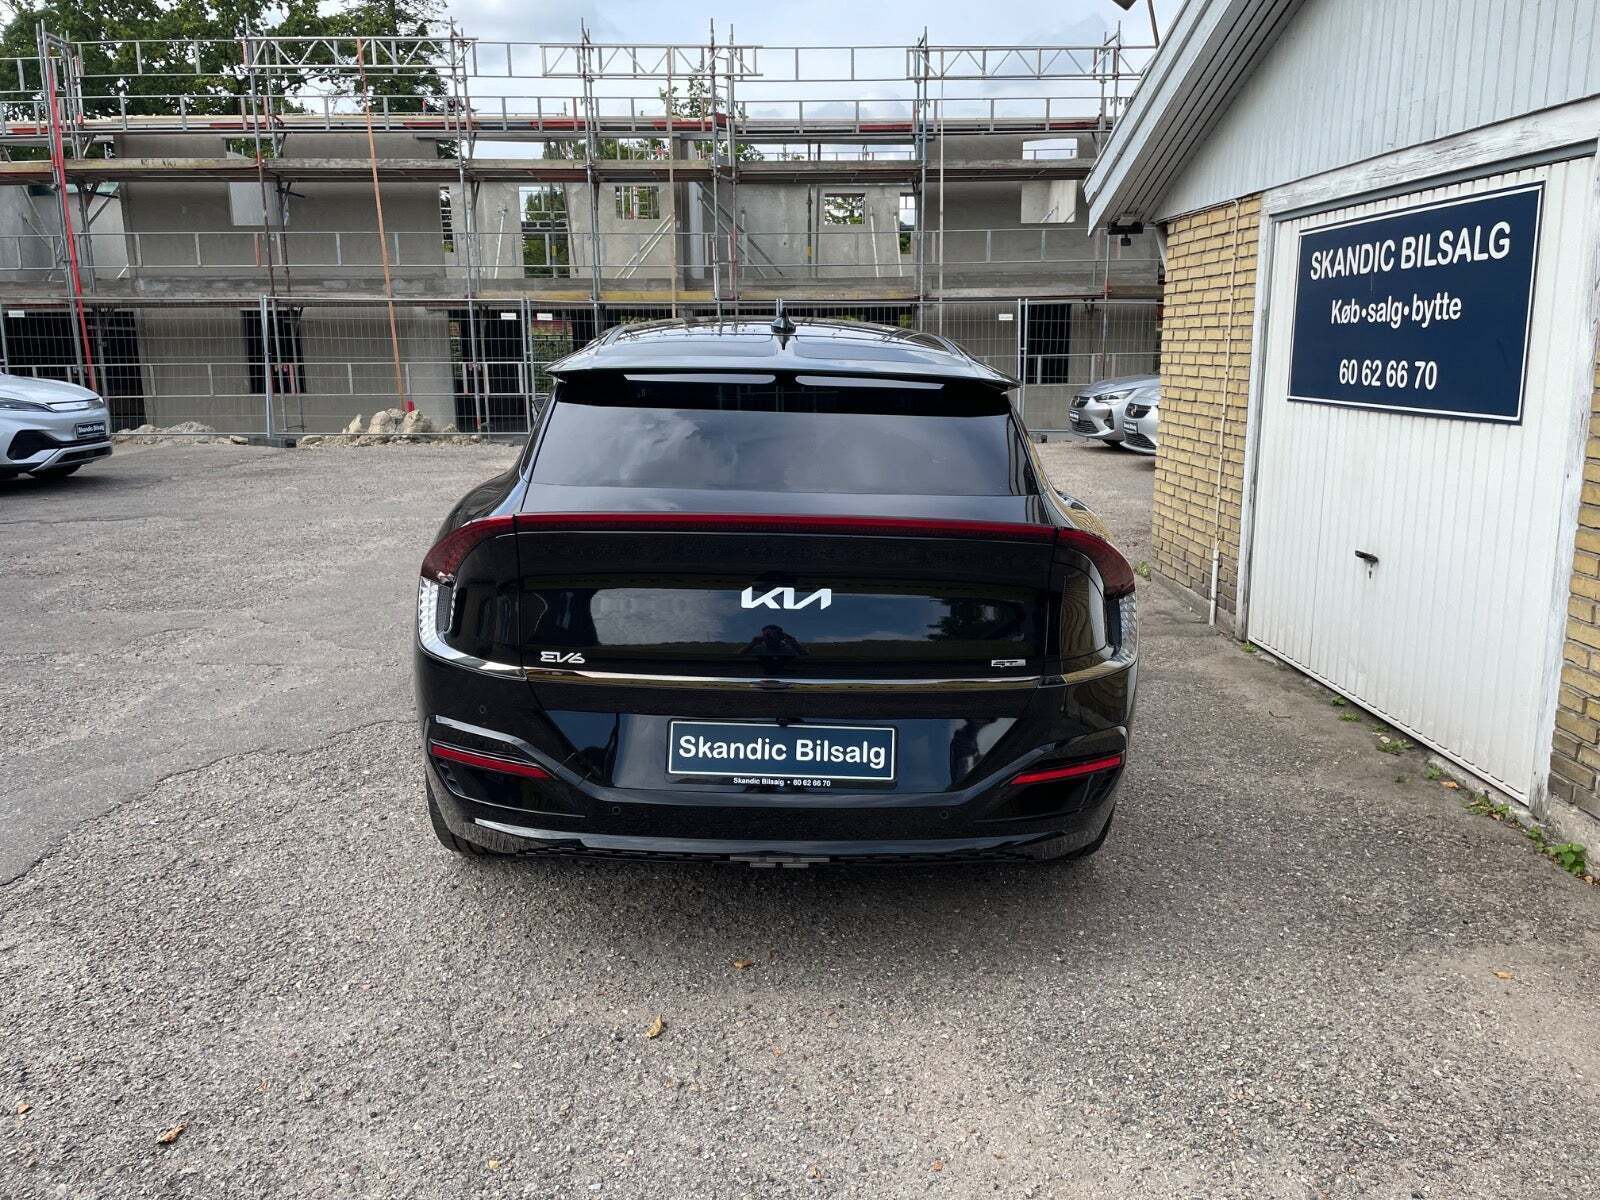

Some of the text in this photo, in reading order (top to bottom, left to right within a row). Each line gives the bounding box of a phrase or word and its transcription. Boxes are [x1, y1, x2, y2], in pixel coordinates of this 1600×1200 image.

[1310, 221, 1511, 281] SKANDIC BILSALG
[1338, 358, 1437, 391] 60 62 66 70
[740, 586, 832, 610] KIA
[540, 651, 586, 664] EV6
[678, 735, 886, 770] Skandic Bilsalg
[733, 777, 761, 785] Skandic
[761, 777, 785, 787] Bilsalg
